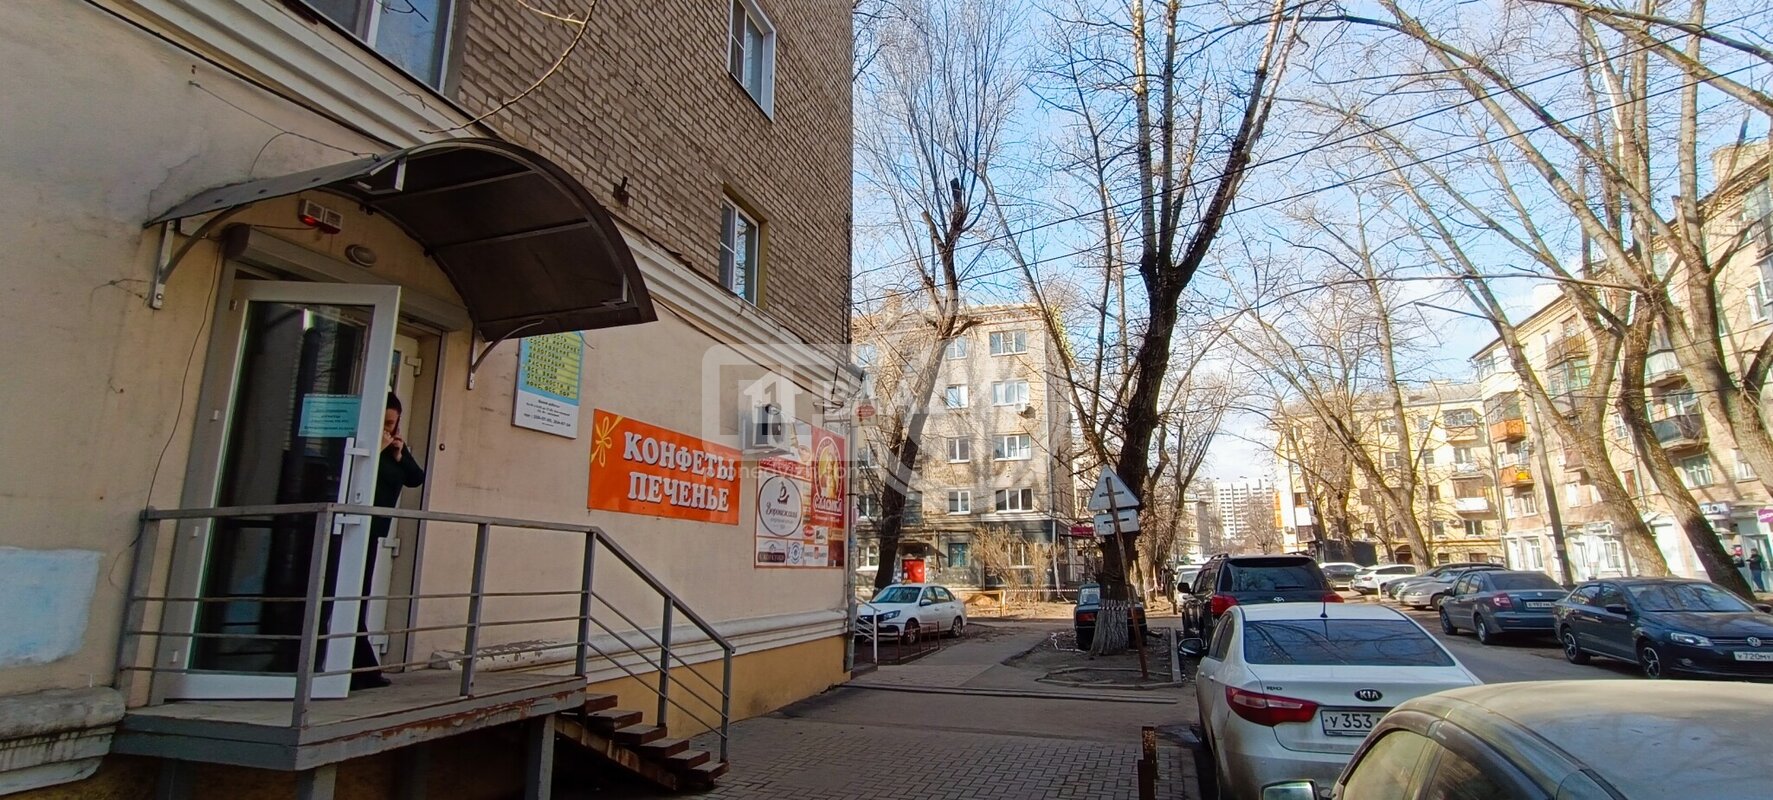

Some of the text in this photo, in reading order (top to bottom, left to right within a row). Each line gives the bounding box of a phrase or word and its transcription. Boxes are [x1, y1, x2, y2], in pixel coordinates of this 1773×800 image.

[623, 431, 736, 482] КОНФЕТЫ
[627, 471, 729, 512] ПЕЧЕНЬЕ
[1359, 690, 1379, 699] KIA
